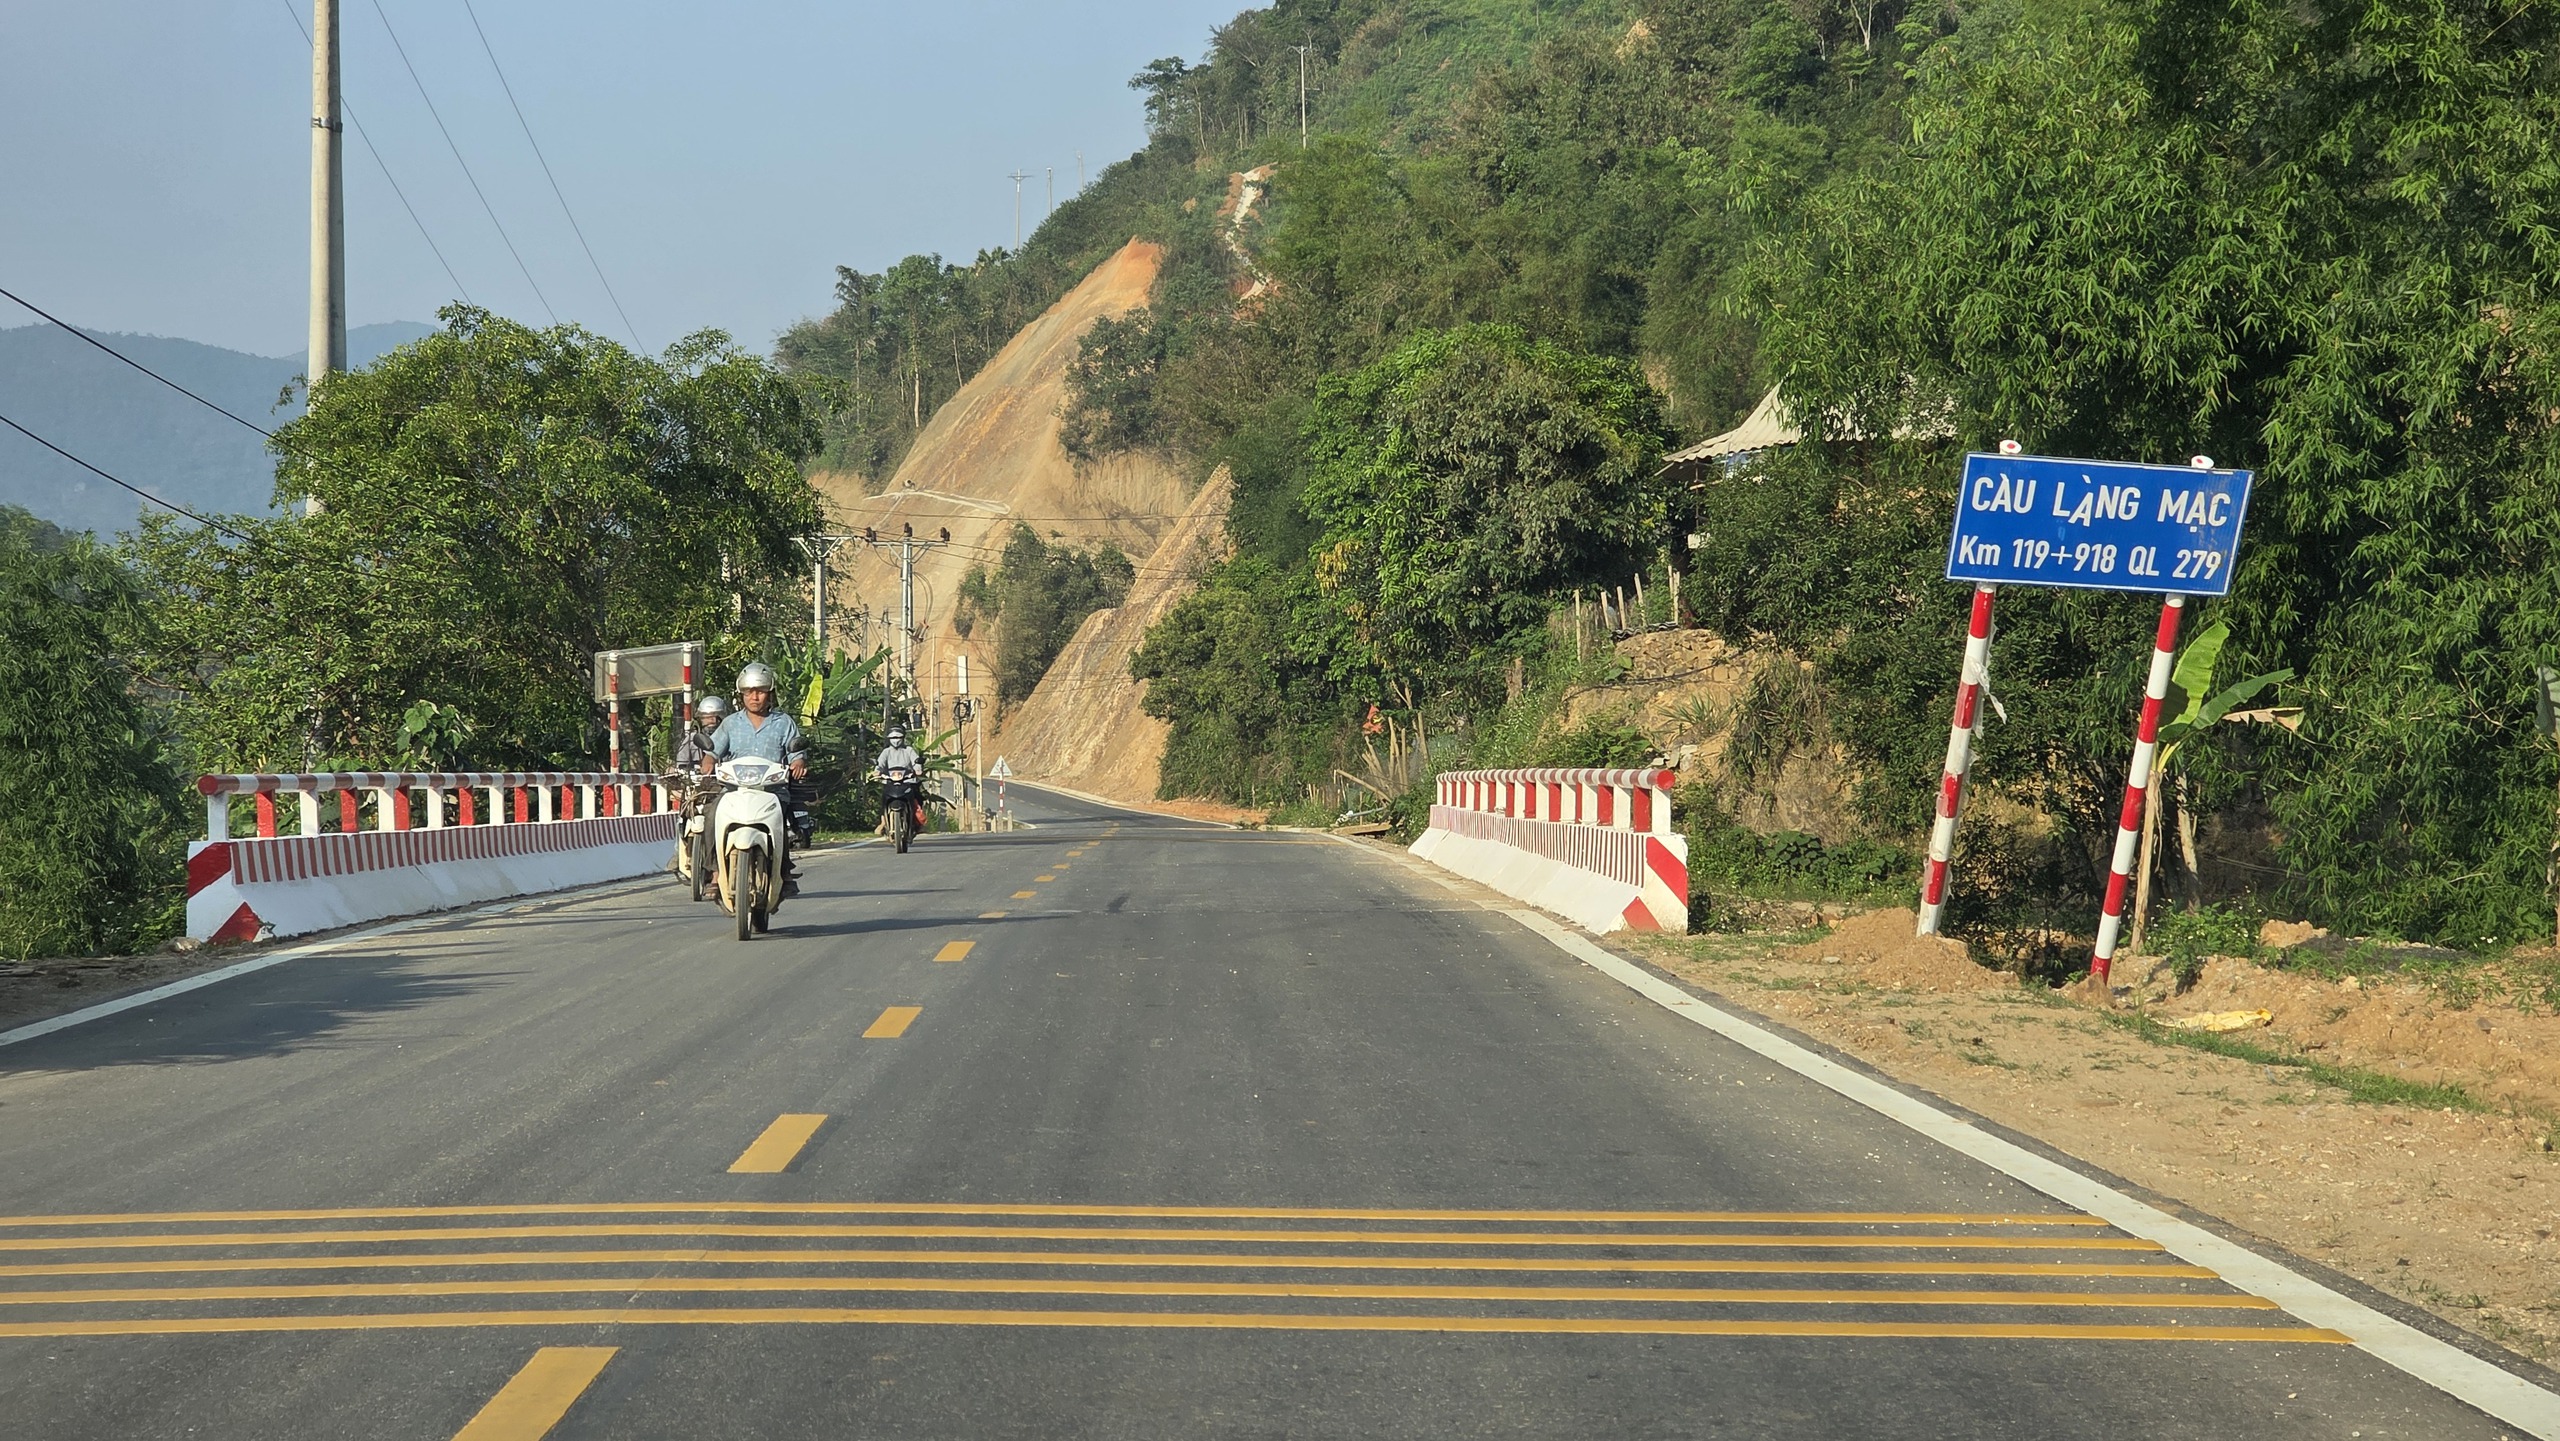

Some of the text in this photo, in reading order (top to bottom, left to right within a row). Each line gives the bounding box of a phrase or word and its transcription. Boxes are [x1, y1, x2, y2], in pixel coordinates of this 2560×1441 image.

[2052, 474, 2141, 527] LÀNG
[2157, 488, 2231, 533] MẠC
[1958, 535, 2222, 580] Km 119+918 QL 279
